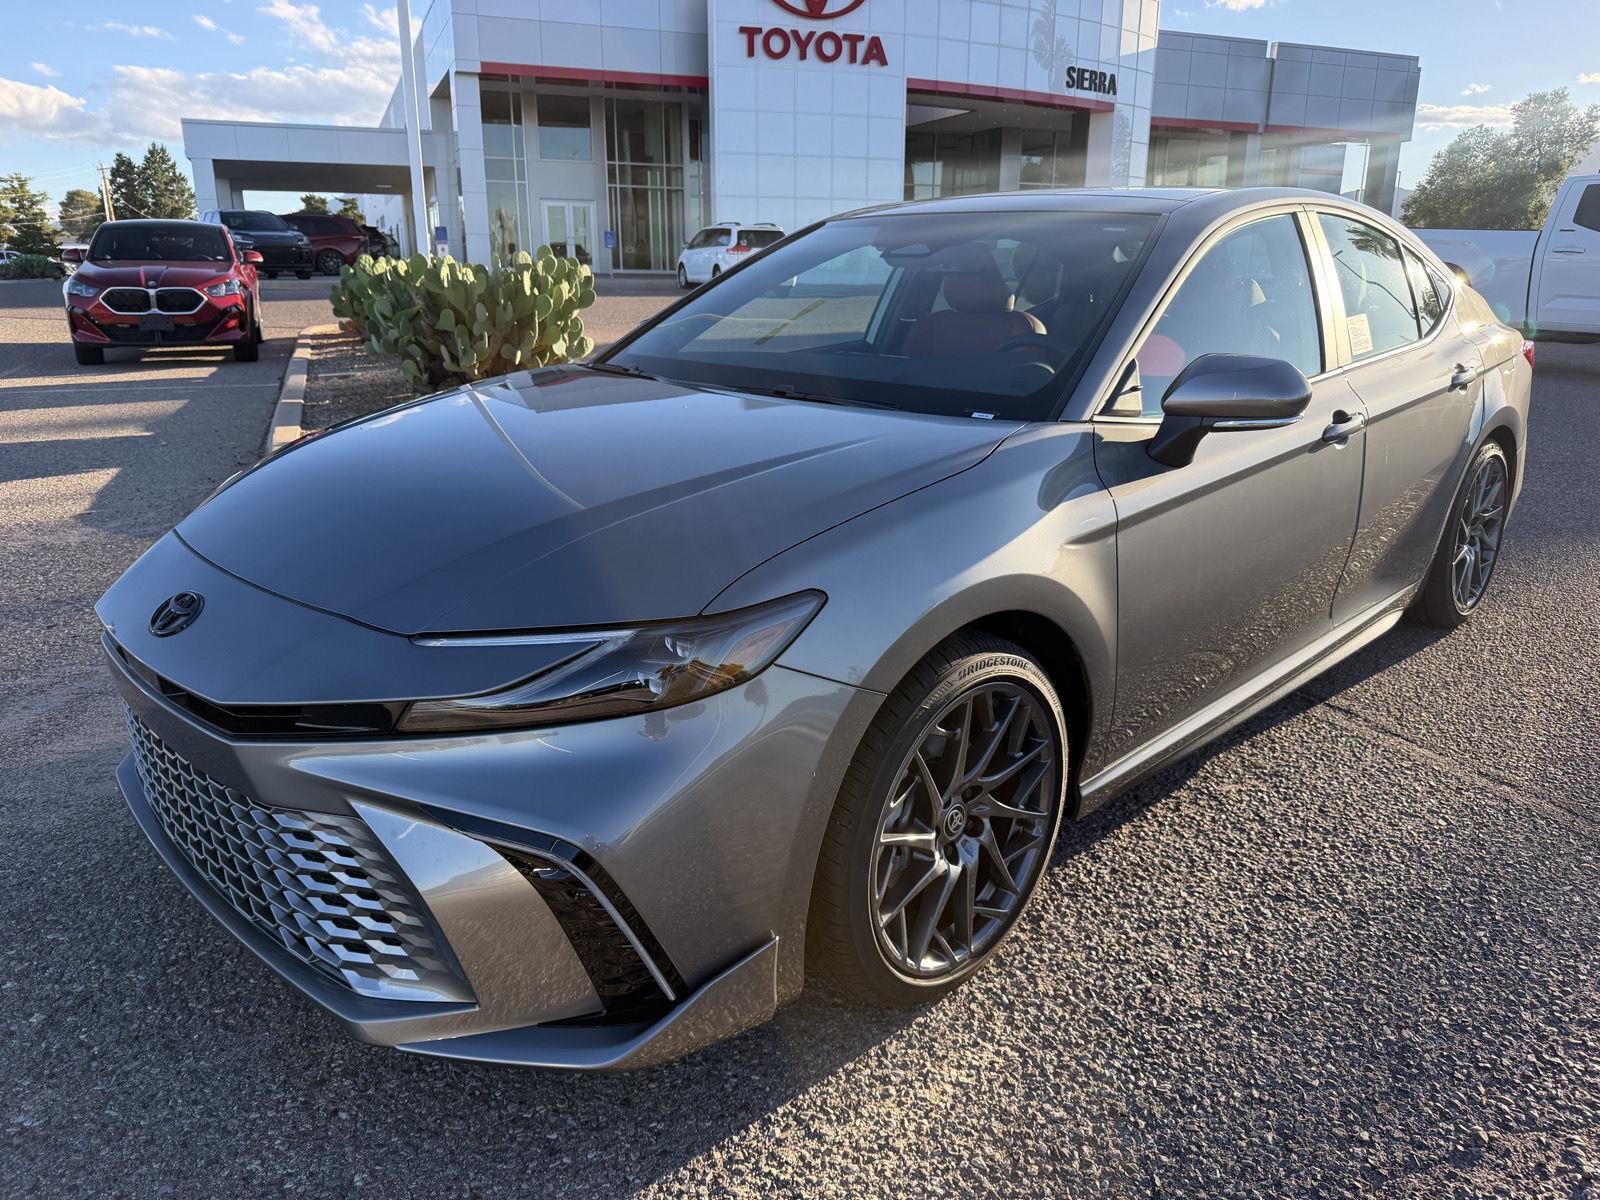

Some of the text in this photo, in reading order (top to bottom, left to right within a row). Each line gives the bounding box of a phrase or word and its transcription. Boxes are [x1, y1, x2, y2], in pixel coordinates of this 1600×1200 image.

[739, 26, 888, 66] TOYOTA
[1066, 65, 1117, 95] SIERRA
[958, 657, 1029, 680] BRIDGESTONE
